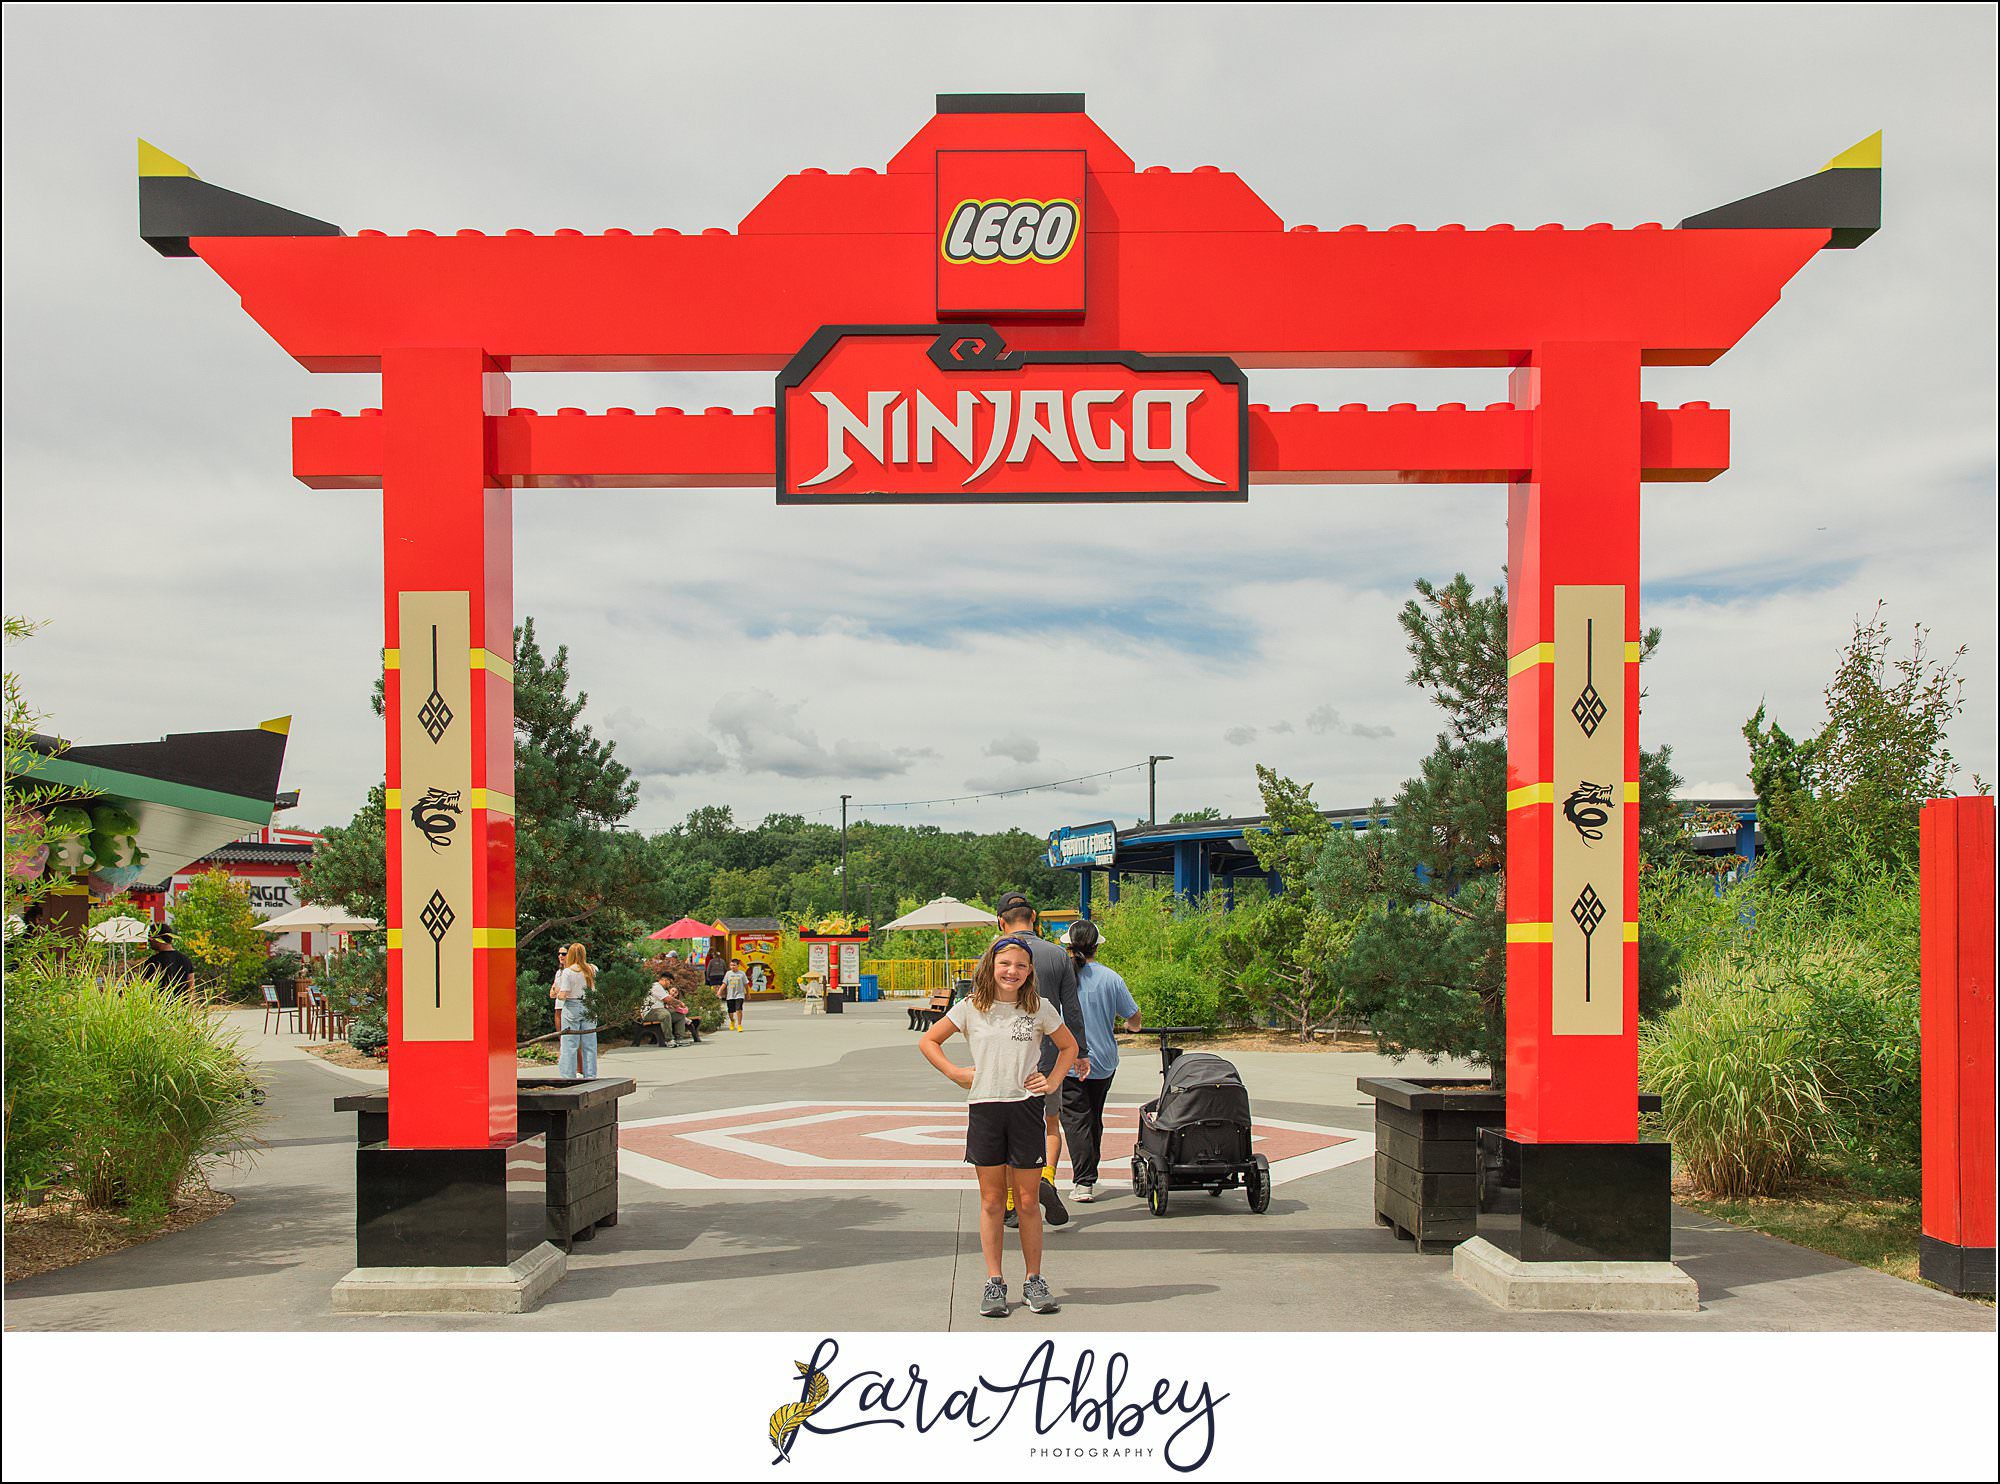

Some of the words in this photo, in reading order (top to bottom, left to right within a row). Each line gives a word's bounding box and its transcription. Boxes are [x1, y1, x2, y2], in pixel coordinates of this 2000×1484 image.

[944, 201, 1077, 261] LEGO
[797, 388, 1227, 487] NINJAGO
[1089, 832, 1112, 853] FORCE
